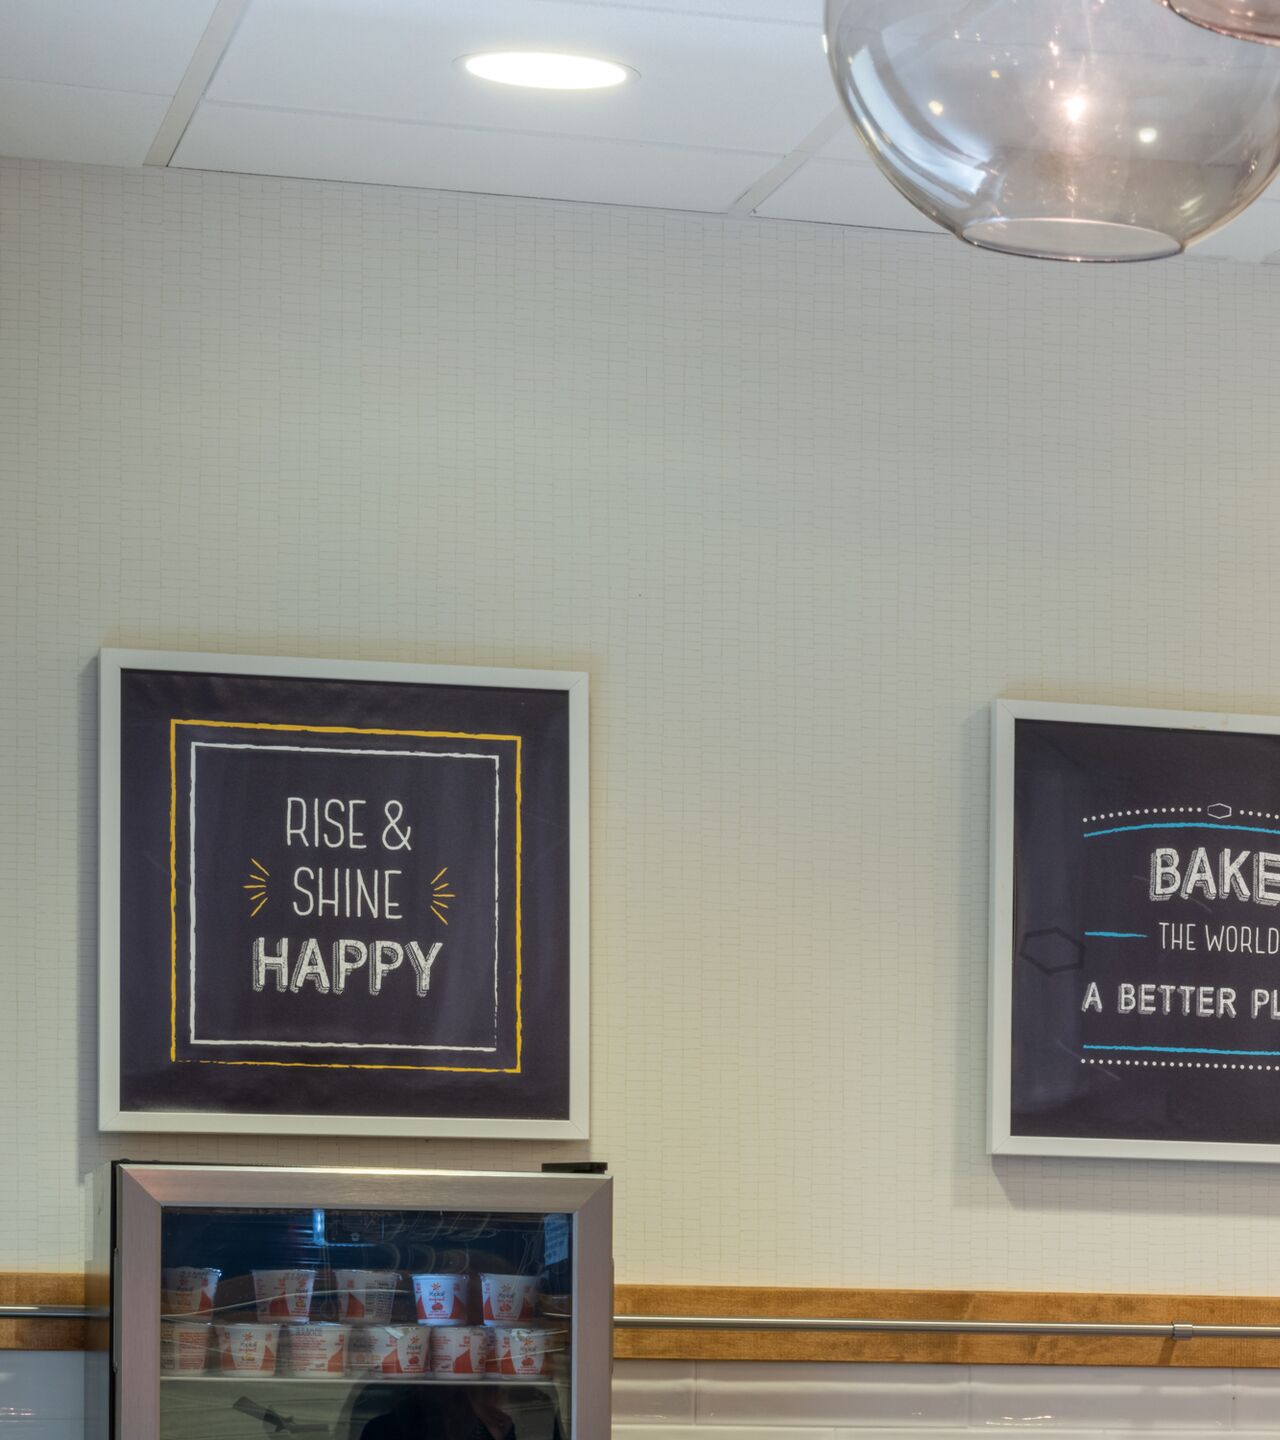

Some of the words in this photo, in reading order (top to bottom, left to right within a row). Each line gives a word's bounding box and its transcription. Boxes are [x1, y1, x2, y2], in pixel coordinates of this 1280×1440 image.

[286, 797, 367, 850] RISE
[381, 799, 412, 851] &
[292, 866, 404, 920] SHINE
[1158, 922, 1197, 951] THE
[1204, 924, 1280, 955] WORLD
[252, 937, 443, 997] HAPPY
[1081, 981, 1103, 1012] A
[1117, 983, 1237, 1018] BETTER
